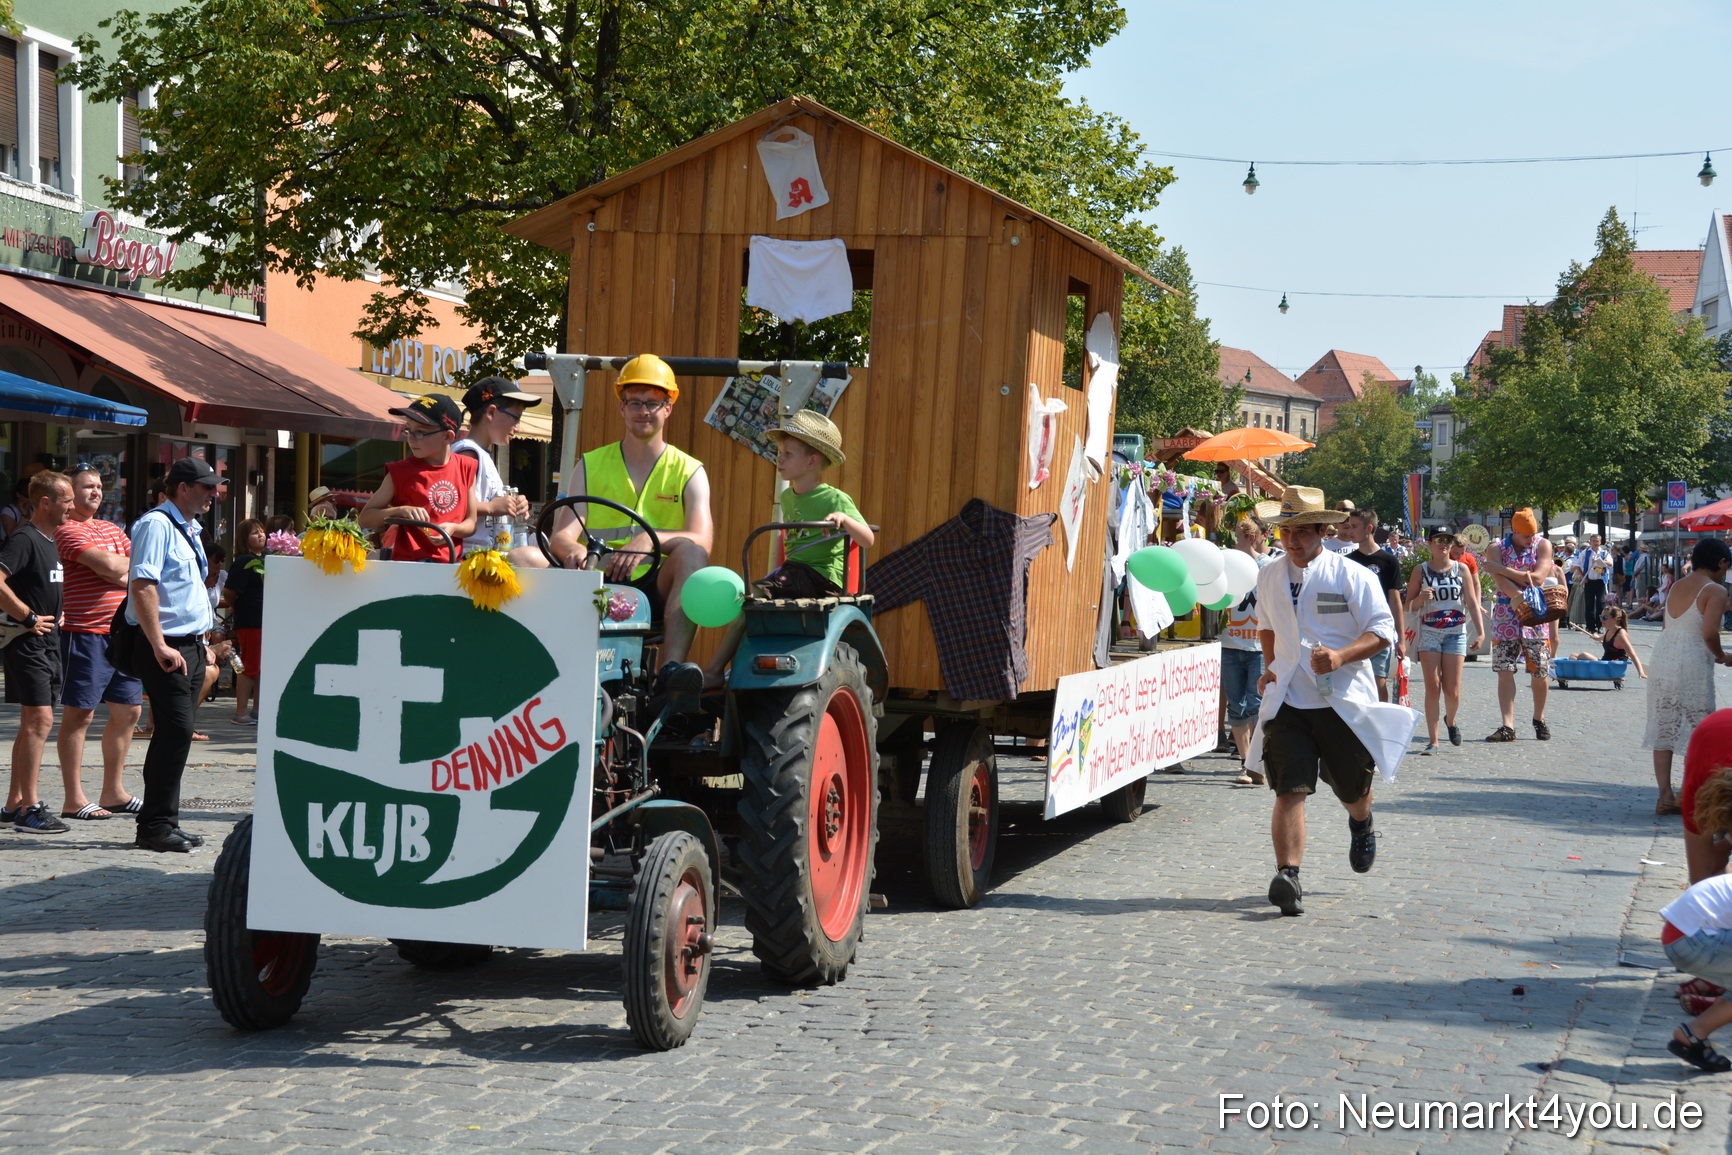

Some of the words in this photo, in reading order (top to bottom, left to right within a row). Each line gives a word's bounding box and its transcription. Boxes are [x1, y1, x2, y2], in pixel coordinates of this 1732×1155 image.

[3, 227, 73, 259] METZGEREI
[87, 210, 180, 282] Bögerl
[372, 339, 425, 381] LEDER
[1135, 663, 1158, 712] leere
[431, 697, 567, 792] DEINING
[307, 801, 431, 878] KLJB
